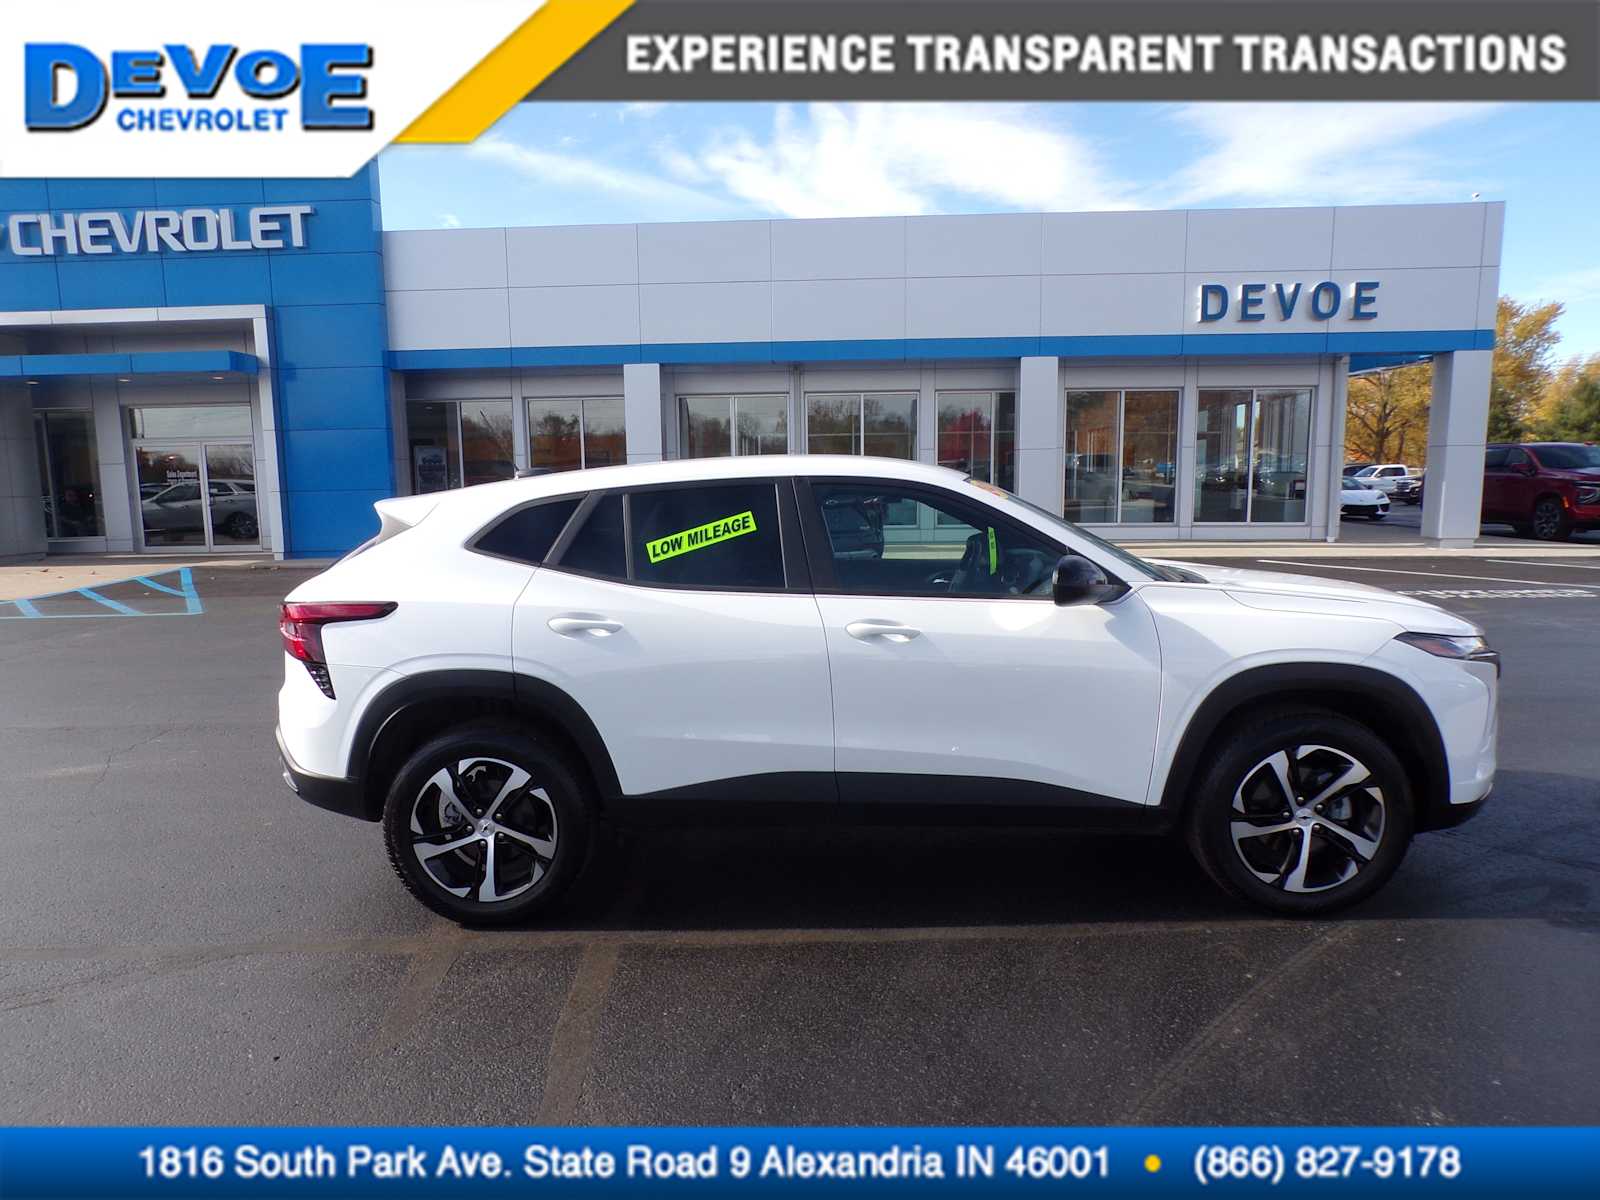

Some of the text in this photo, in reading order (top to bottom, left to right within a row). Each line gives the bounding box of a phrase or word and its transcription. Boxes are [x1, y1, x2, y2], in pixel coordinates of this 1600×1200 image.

[8, 205, 313, 256] CHEVROLET
[1199, 281, 1380, 322] DEVOE
[652, 515, 751, 558] LOW MILEAGE
